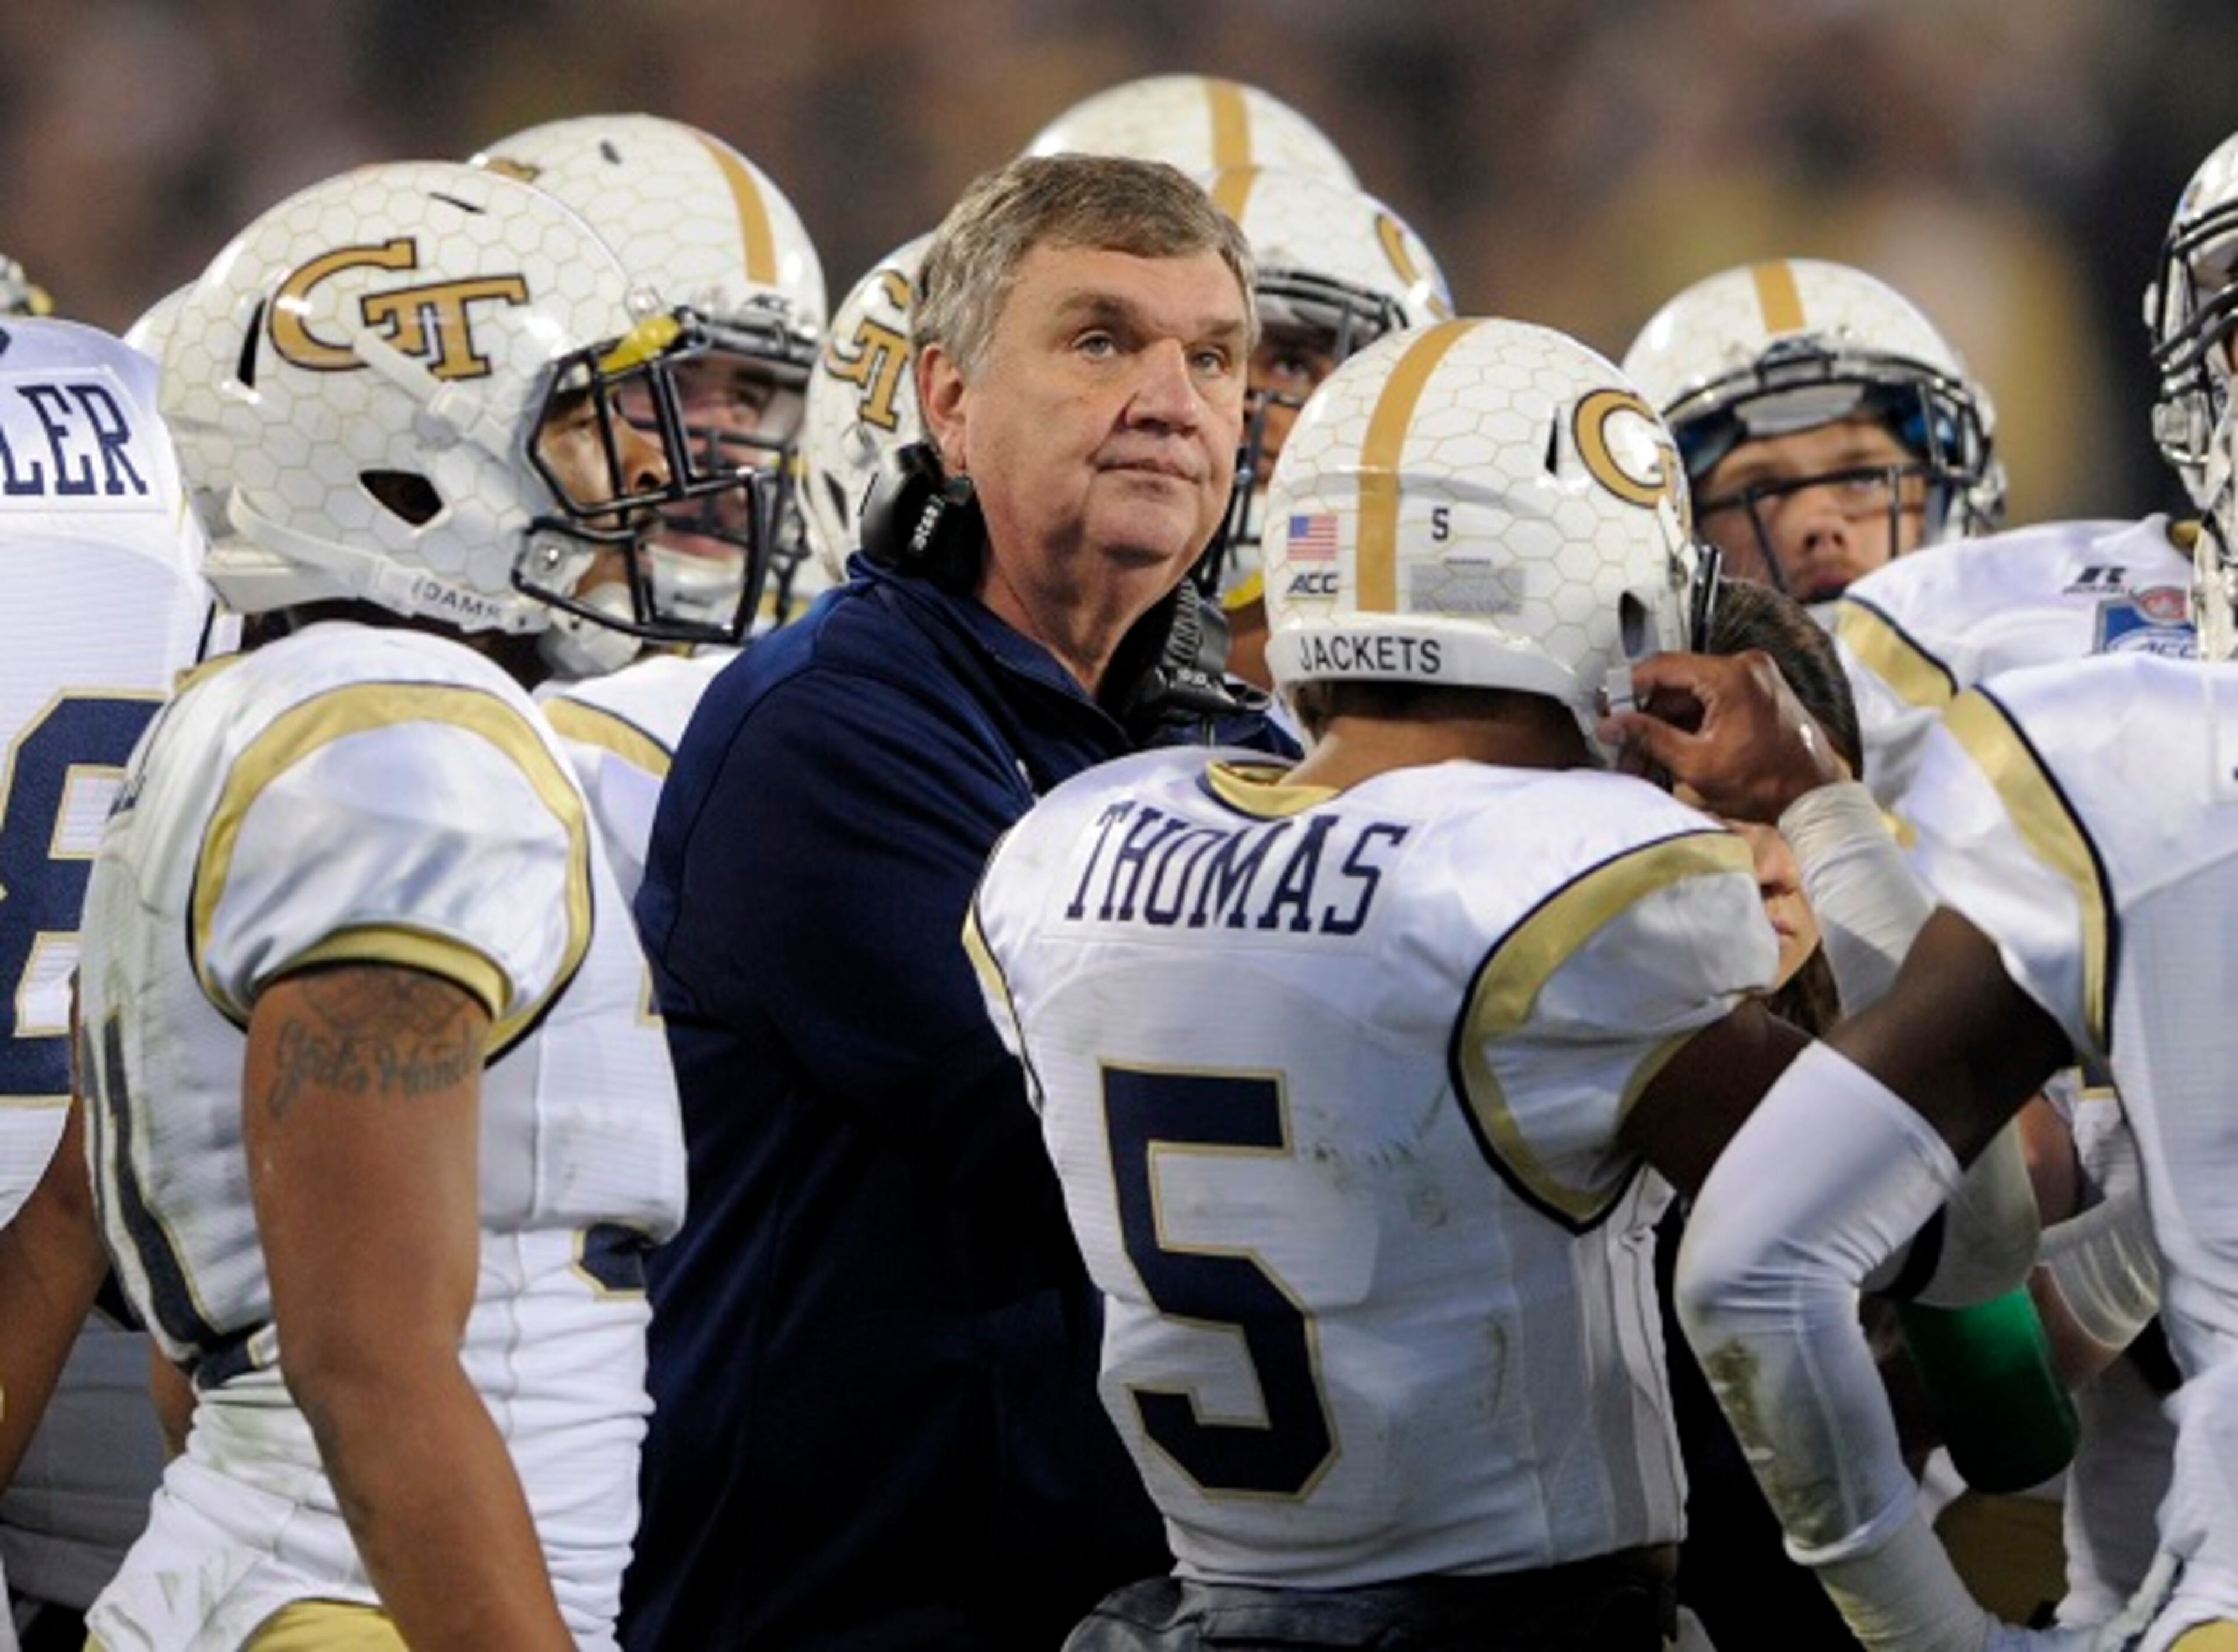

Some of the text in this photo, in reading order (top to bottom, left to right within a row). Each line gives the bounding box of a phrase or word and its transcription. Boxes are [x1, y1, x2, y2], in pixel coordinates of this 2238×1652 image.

[1286, 573, 1339, 594] ACC
[1299, 635, 1441, 674] JACKETS
[1064, 800, 1412, 935] THOMAS
[1098, 1061, 1342, 1502] 5
